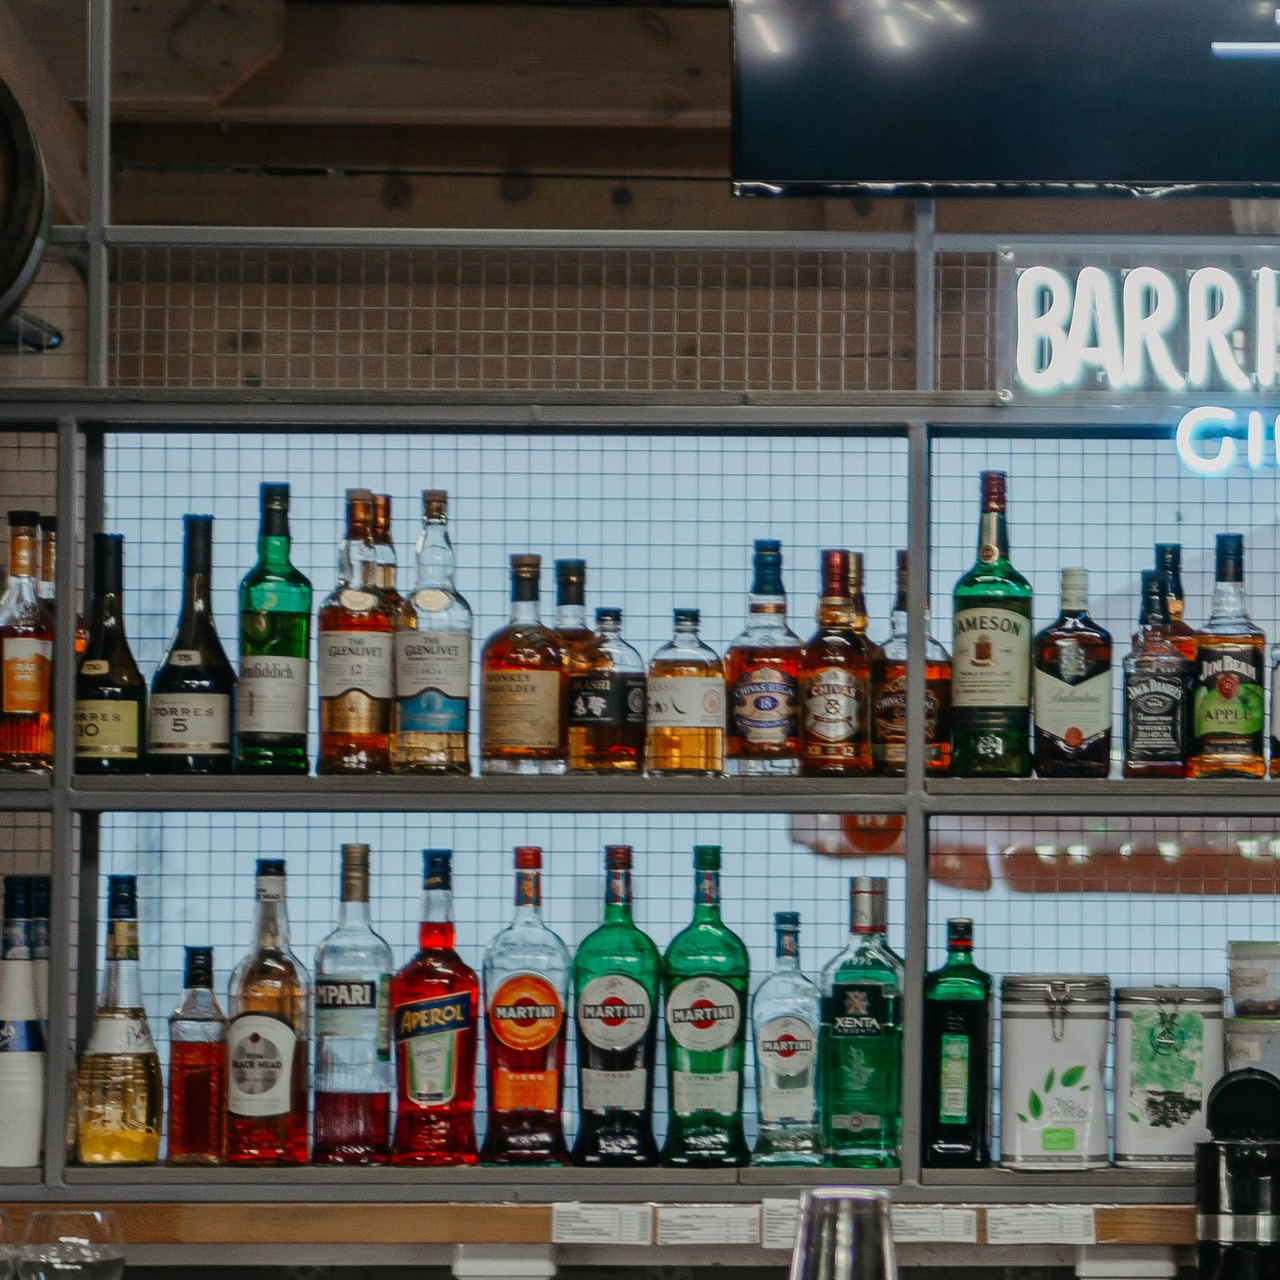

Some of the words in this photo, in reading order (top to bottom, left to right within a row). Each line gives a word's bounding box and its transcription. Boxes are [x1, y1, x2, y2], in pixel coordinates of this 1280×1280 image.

[955, 615, 1023, 637] JAMESON
[422, 636, 440, 645] THE
[328, 646, 383, 658] GLENLIVET
[405, 645, 460, 657] GLENLIVET
[735, 685, 767, 698] CHIVAS
[811, 684, 856, 698] CHIVAS
[154, 707, 215, 718] TORRES
[1204, 708, 1254, 720] APPLE
[171, 718, 189, 733] 5
[316, 984, 372, 1005] MPARI
[401, 1004, 465, 1034] APEROL
[495, 1005, 556, 1019] MARTINI
[584, 1005, 645, 1019] MARTINI
[673, 1006, 734, 1023] MARTINI
[834, 1016, 881, 1030] XENTA
[762, 1040, 812, 1052] MARTINI
